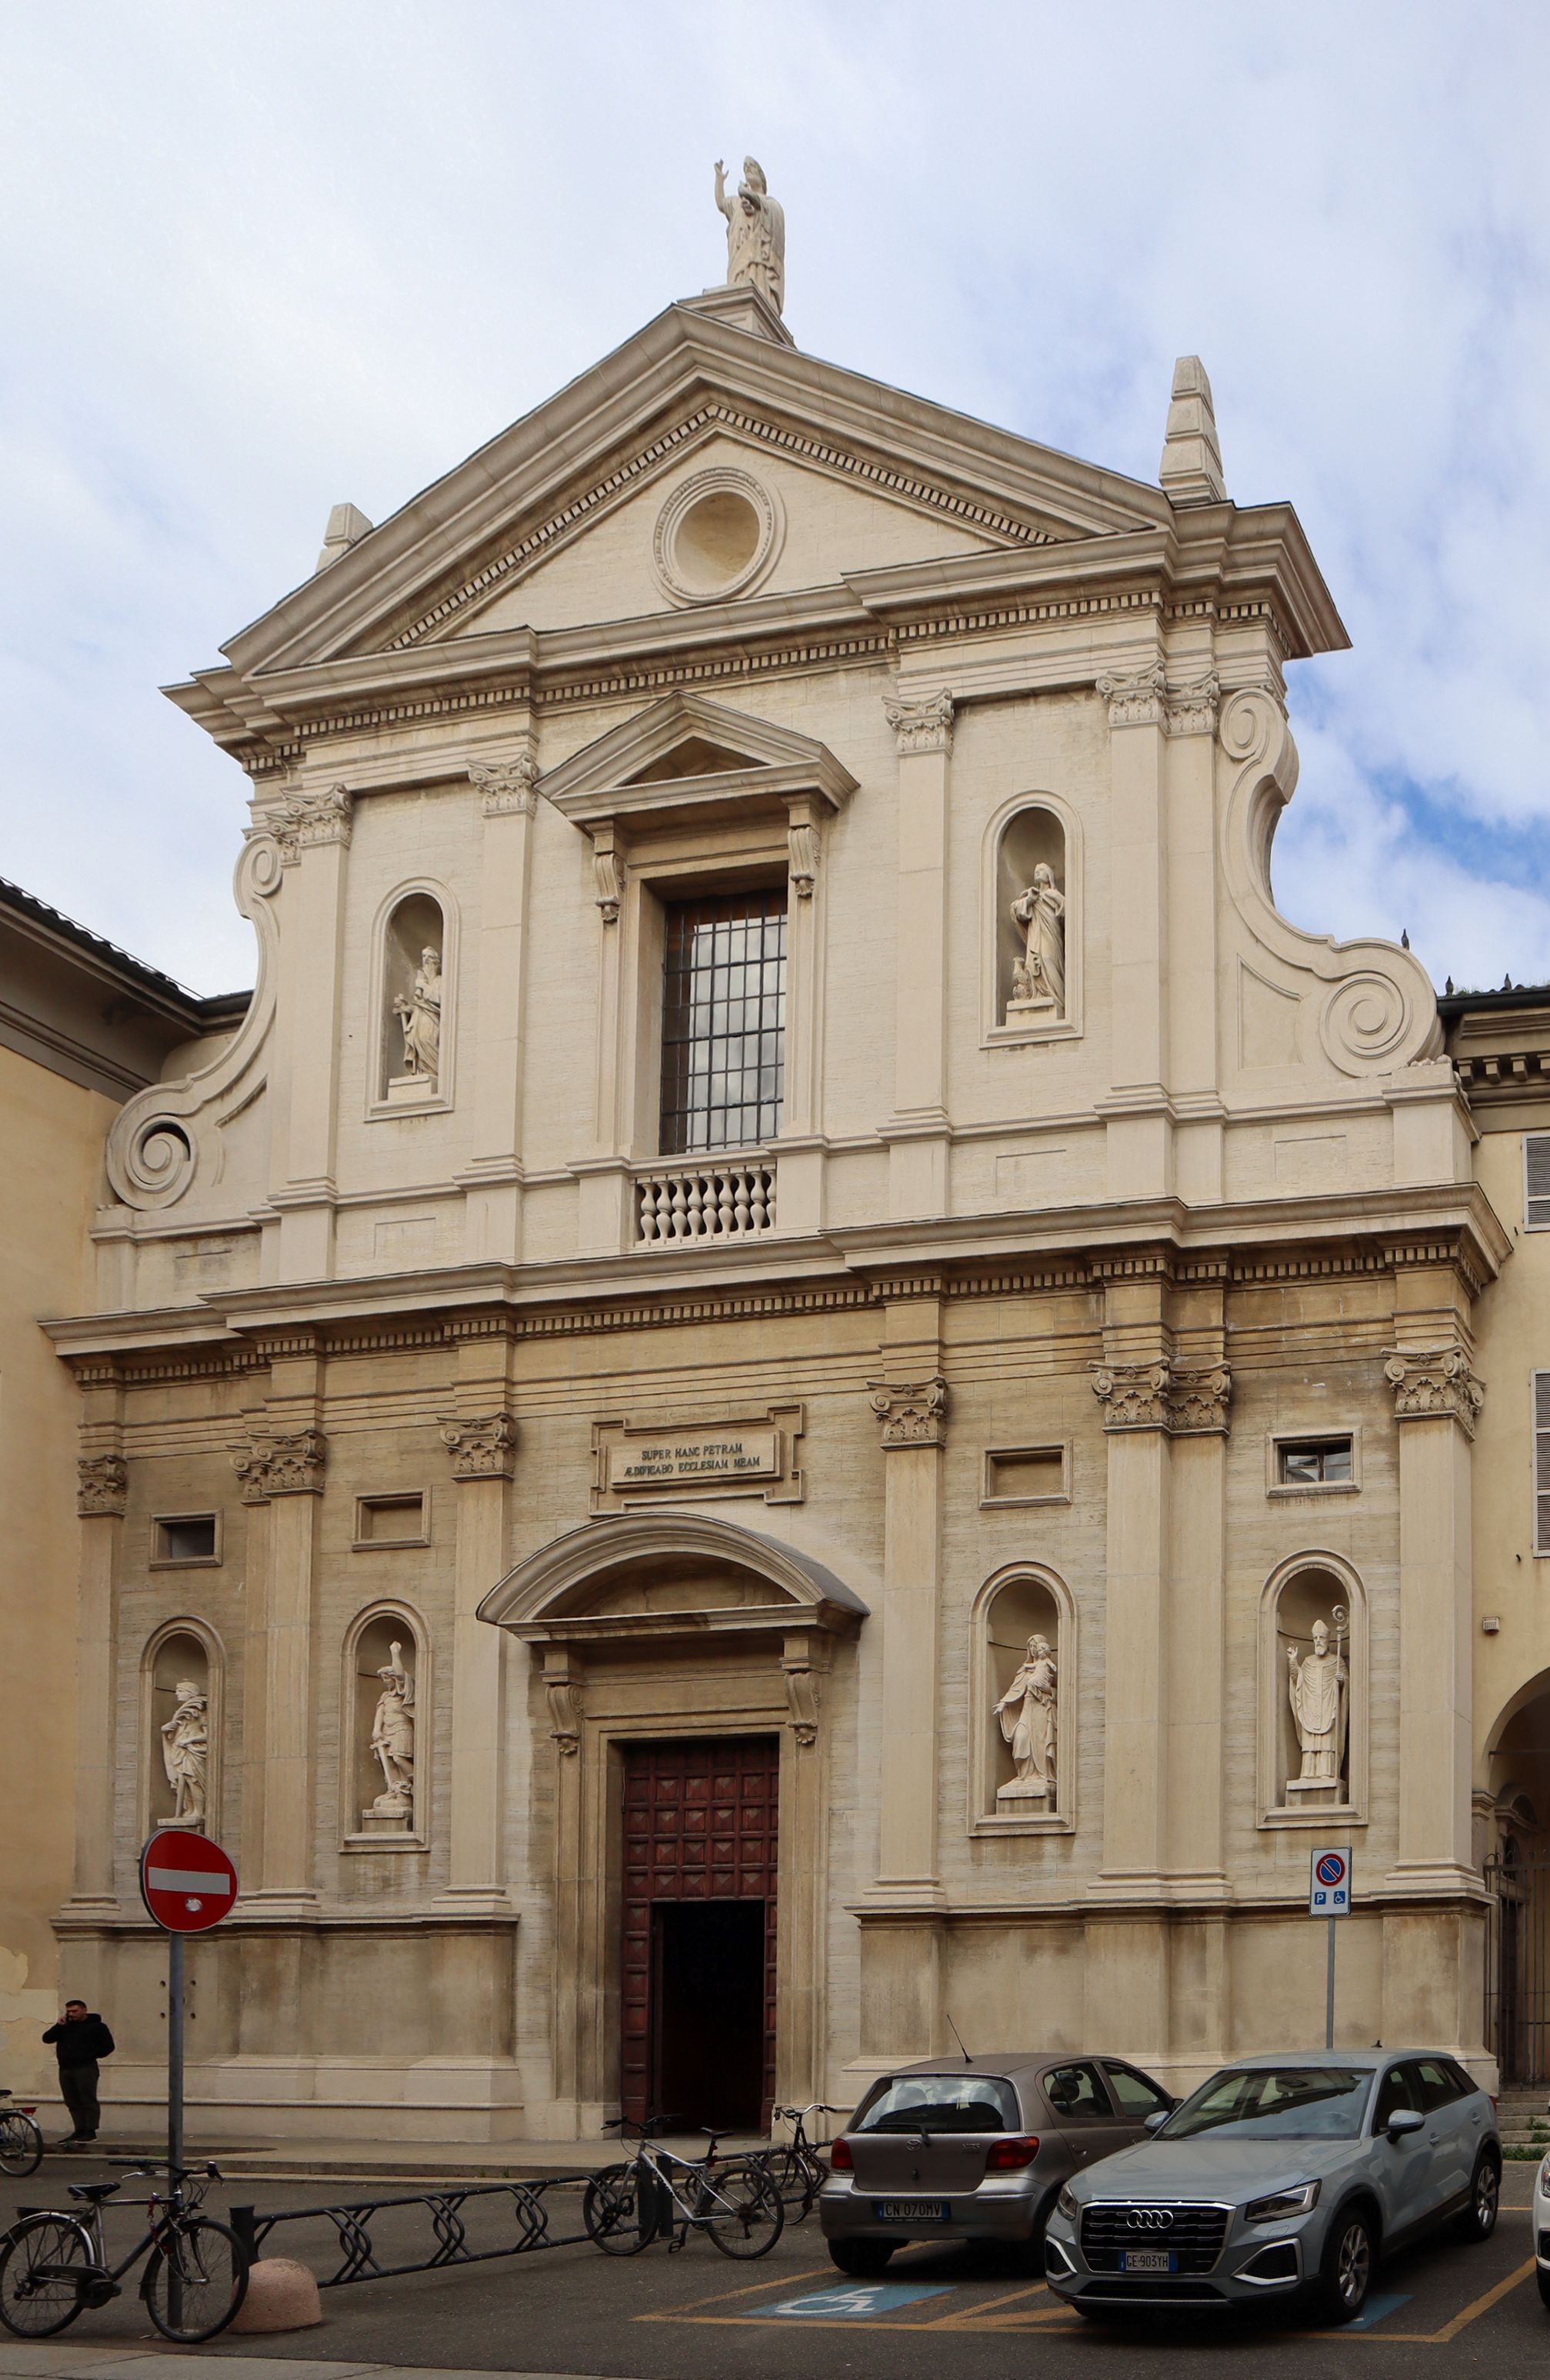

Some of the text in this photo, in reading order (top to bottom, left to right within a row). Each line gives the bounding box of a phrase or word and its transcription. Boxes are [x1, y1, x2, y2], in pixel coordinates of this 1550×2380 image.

[642, 1443, 742, 1460] SUPER HANC PETRAM
[678, 1459, 728, 1472] ECCLESIAM
[733, 1456, 760, 1468] MEAM
[1316, 1894, 1324, 1904] P
